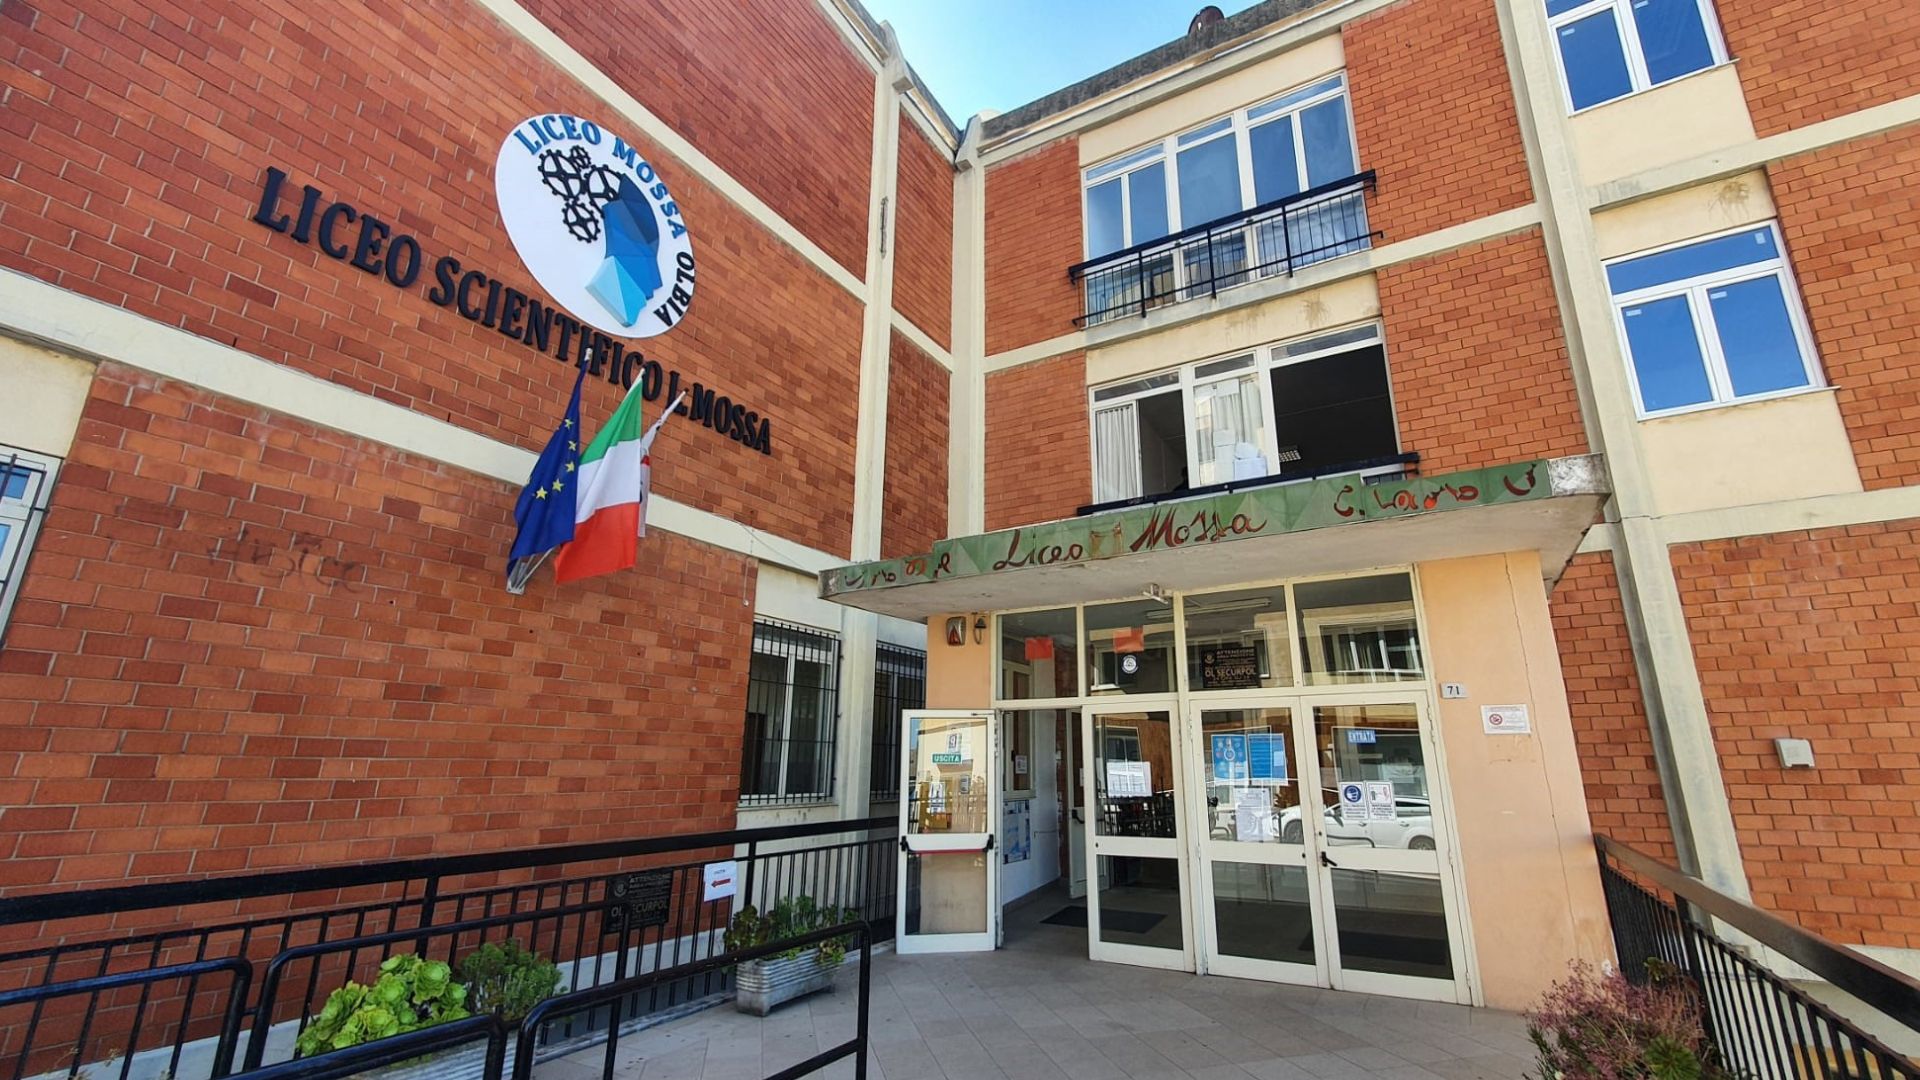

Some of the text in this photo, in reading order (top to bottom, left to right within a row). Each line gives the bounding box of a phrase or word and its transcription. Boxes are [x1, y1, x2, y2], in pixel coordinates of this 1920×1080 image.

[514, 115, 695, 327] LICEO MOSSA OLBIA
[253, 166, 422, 288] LICEO
[429, 256, 663, 401] SCIENTIFICO
[992, 528, 1083, 571] Liceo
[1446, 685, 1460, 695] 71
[934, 754, 960, 762] USCITA
